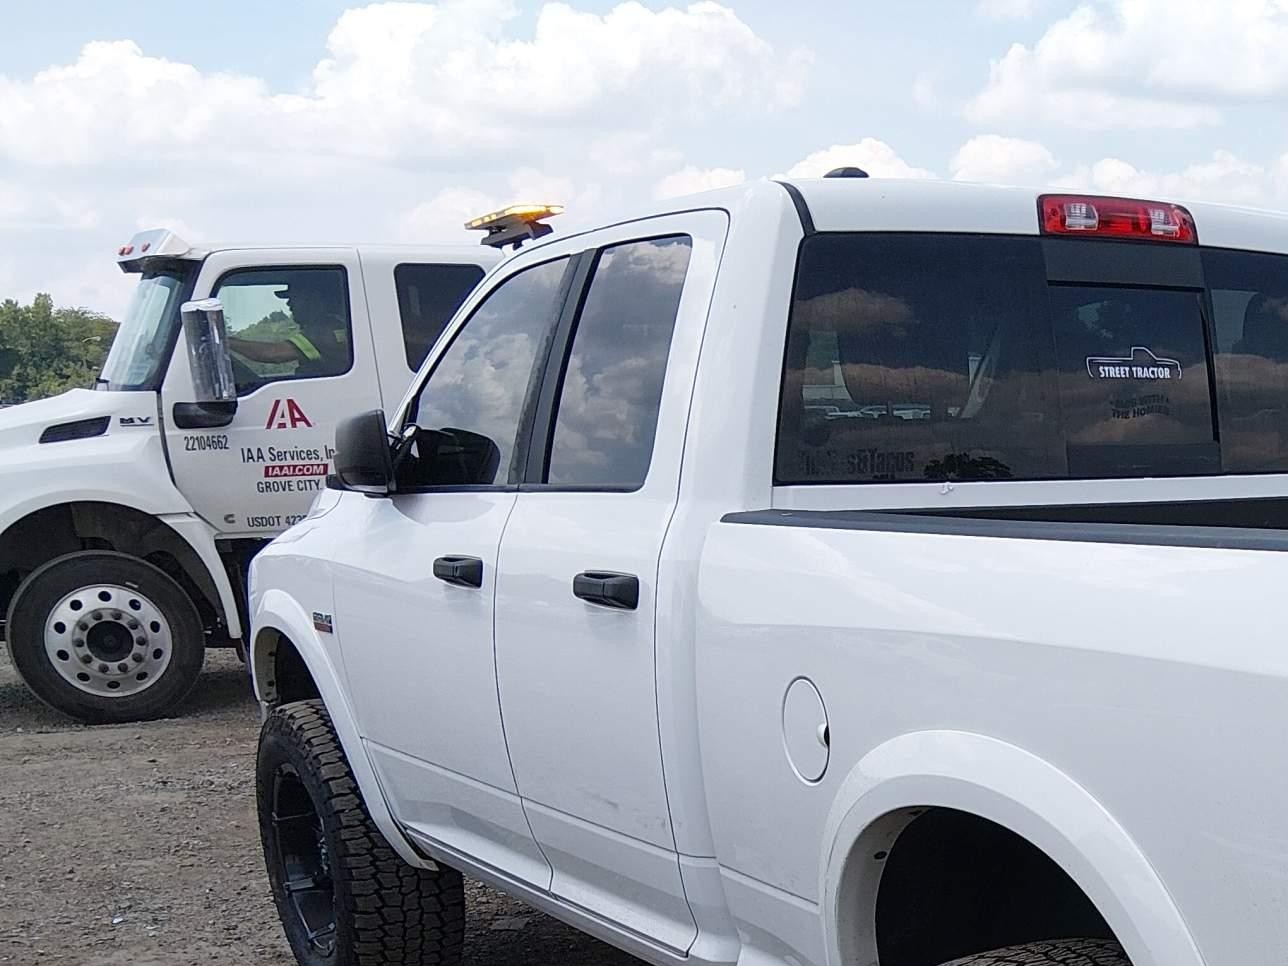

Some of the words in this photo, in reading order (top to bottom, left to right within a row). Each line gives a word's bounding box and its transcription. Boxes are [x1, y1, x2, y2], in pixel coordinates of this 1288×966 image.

[1098, 366, 1130, 378] STREET
[1132, 367, 1171, 379] TRACTOR
[184, 434, 230, 452] 22104662
[241, 447, 266, 463] IAA
[268, 446, 324, 463] Services,
[268, 465, 325, 476] IAAI.COM
[257, 481, 294, 494] GROVE
[247, 516, 281, 528] USDOT
